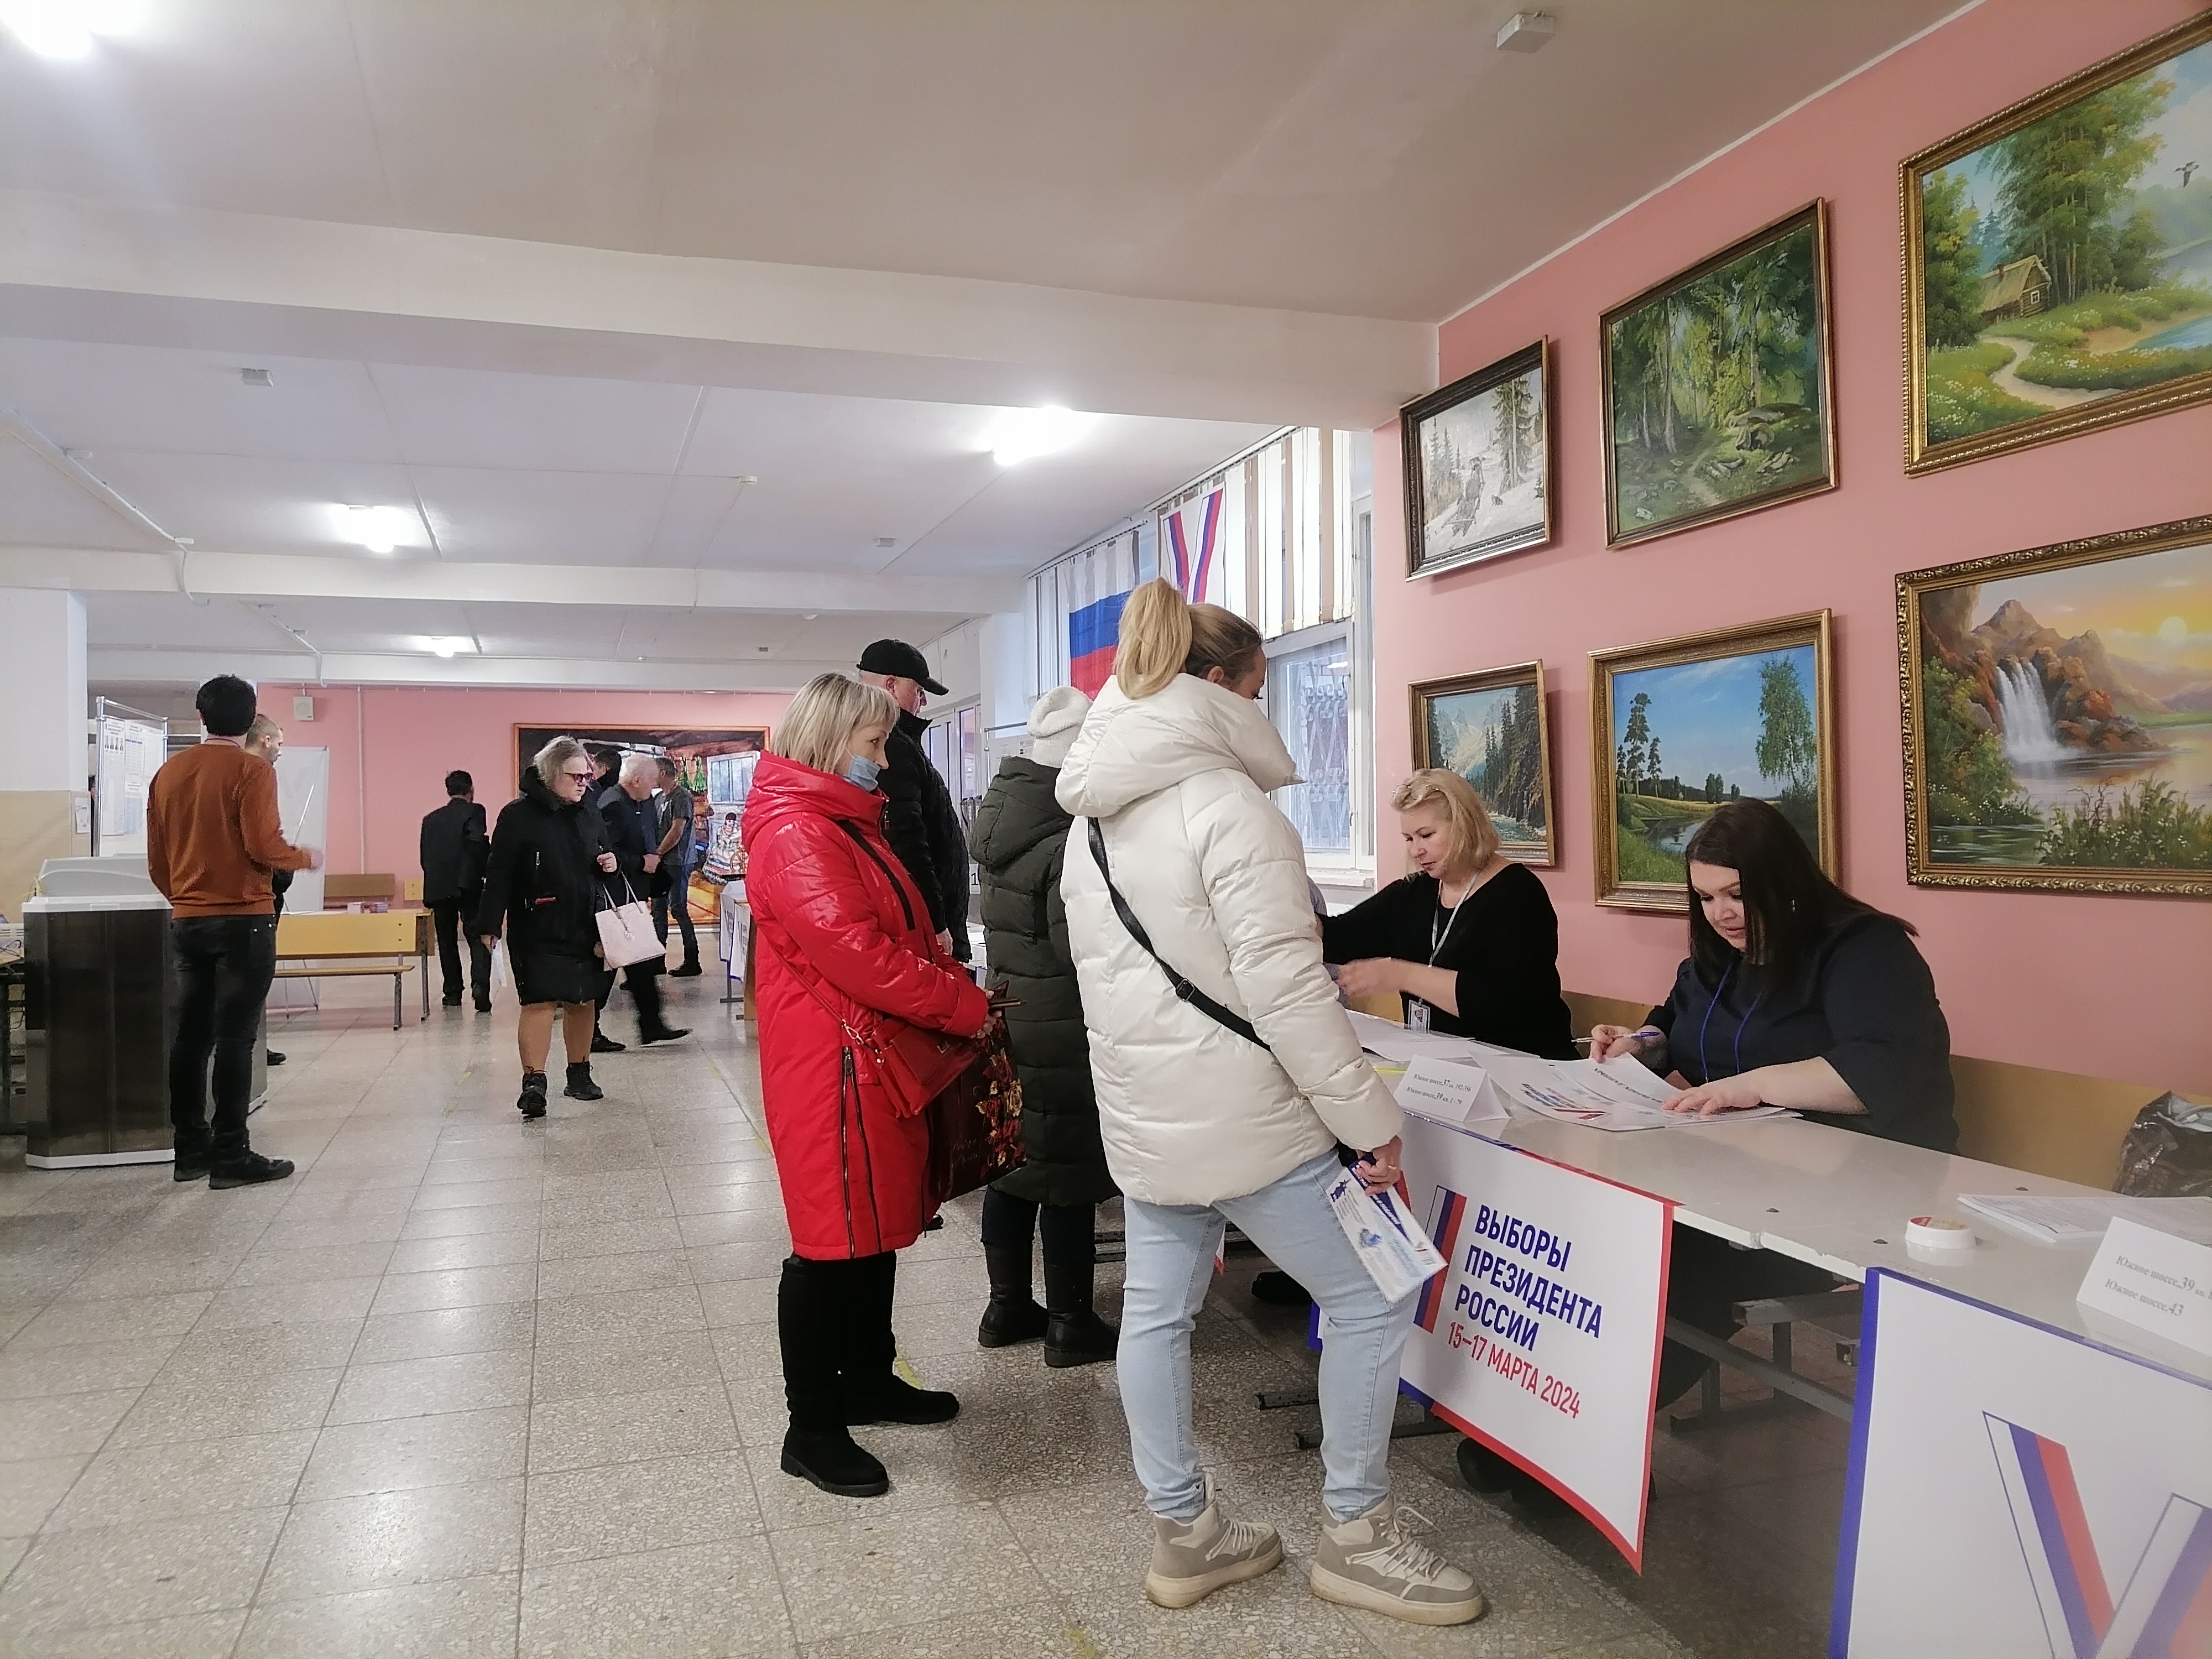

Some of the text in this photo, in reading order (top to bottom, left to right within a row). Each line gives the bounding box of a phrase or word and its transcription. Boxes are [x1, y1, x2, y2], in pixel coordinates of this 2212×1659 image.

[1474, 1204, 1572, 1272] ВЫБОРЫ
[2116, 1255, 2150, 1276] Южное
[1454, 1284, 1540, 1352] РОССИИ
[1464, 1244, 1603, 1339] ПРЕЗИДЕНТА
[2105, 1279, 2139, 1300] Южное
[1487, 1343, 1540, 1395] МАРТА
[1540, 1375, 1582, 1420] 2024
